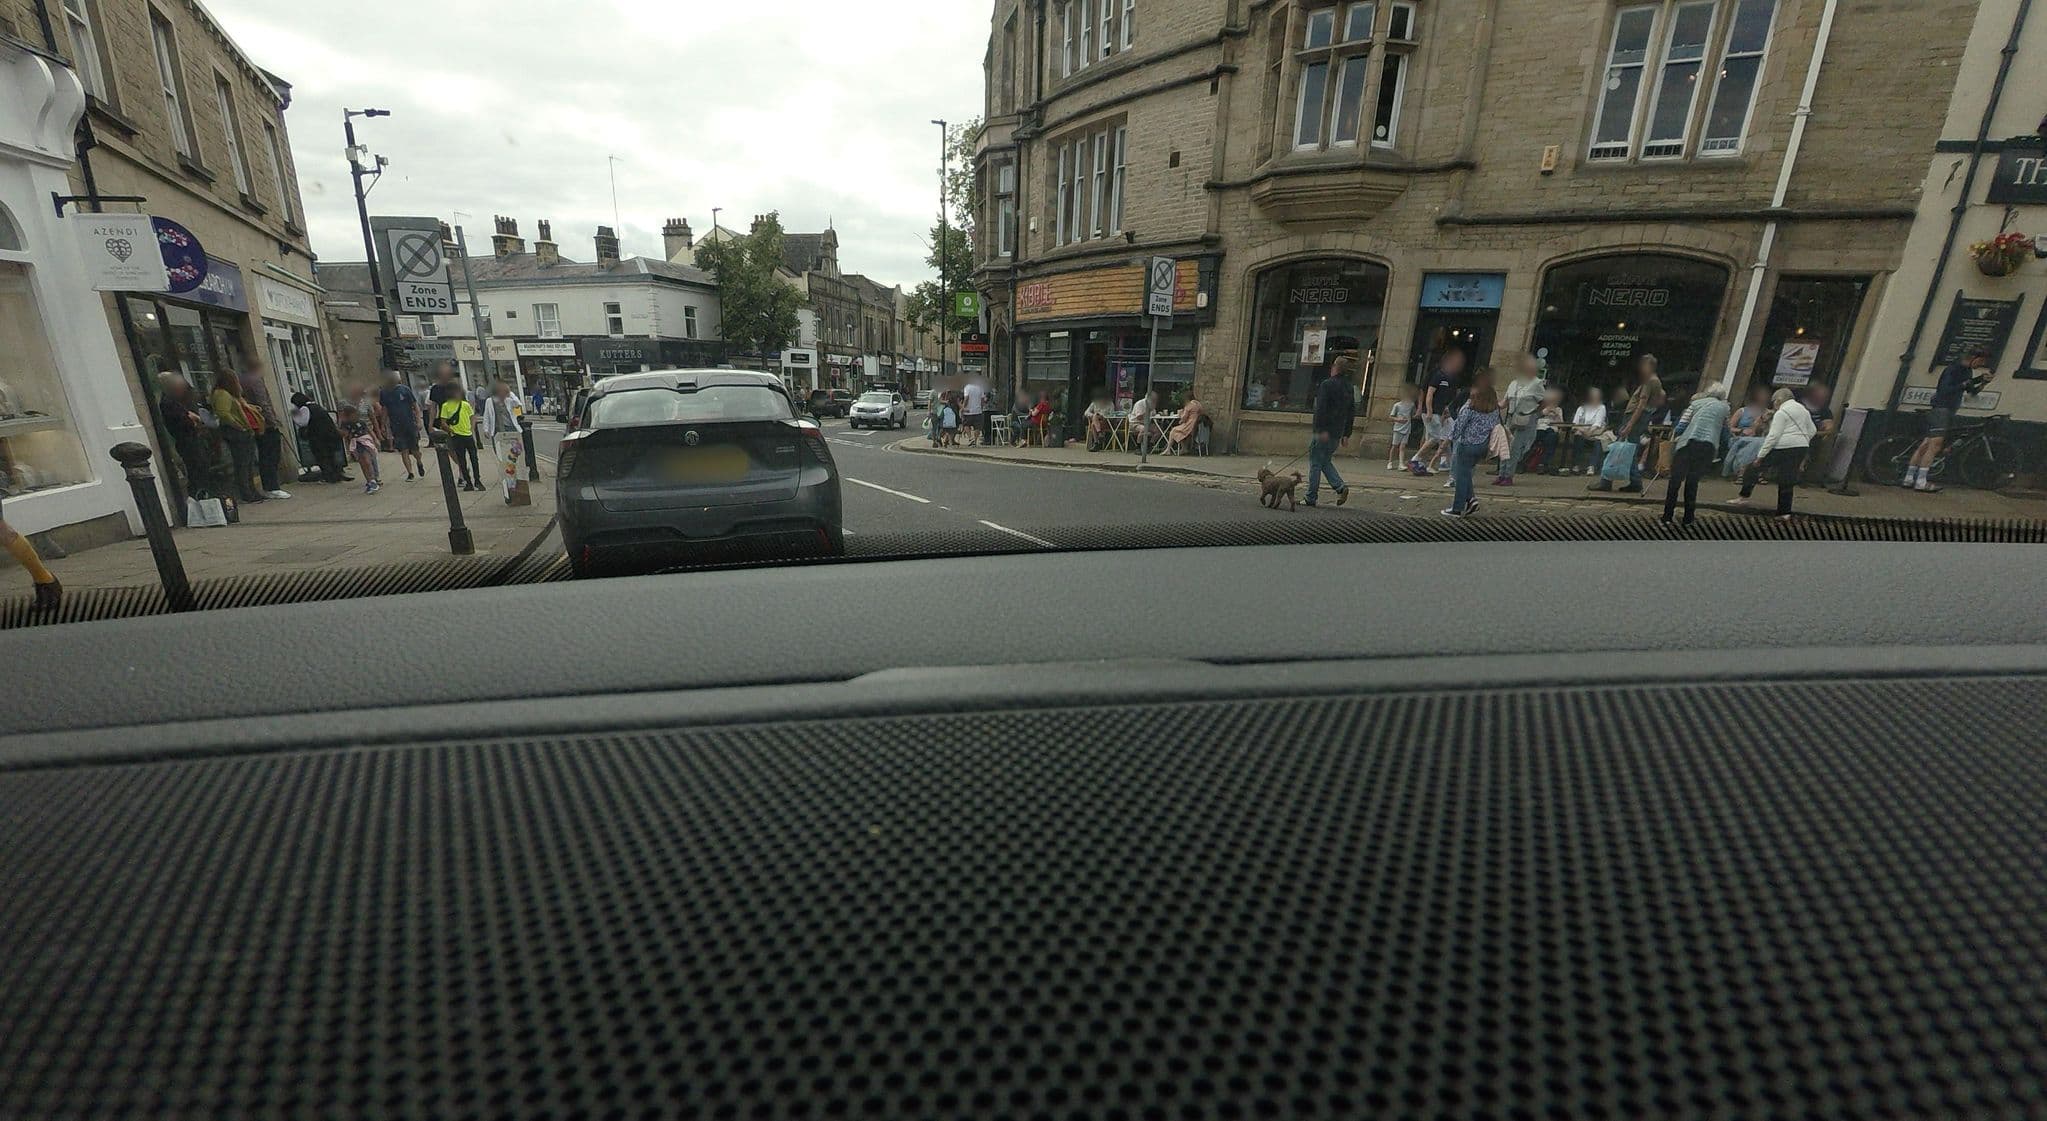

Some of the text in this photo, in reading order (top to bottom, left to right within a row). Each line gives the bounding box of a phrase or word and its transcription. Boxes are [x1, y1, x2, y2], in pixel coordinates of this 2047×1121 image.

[93, 228, 138, 236] AZENDI
[410, 284, 437, 295] Zone
[1290, 288, 1349, 304] NERO
[1589, 287, 1669, 306] NERO
[405, 297, 447, 308] ENDS
[1151, 303, 1170, 313] ENDS
[1597, 334, 1640, 342] ADDITIONAL
[1602, 342, 1637, 350] SEATING
[600, 349, 641, 359] KUTTERS
[1599, 349, 1636, 357] UPSTAIRS
